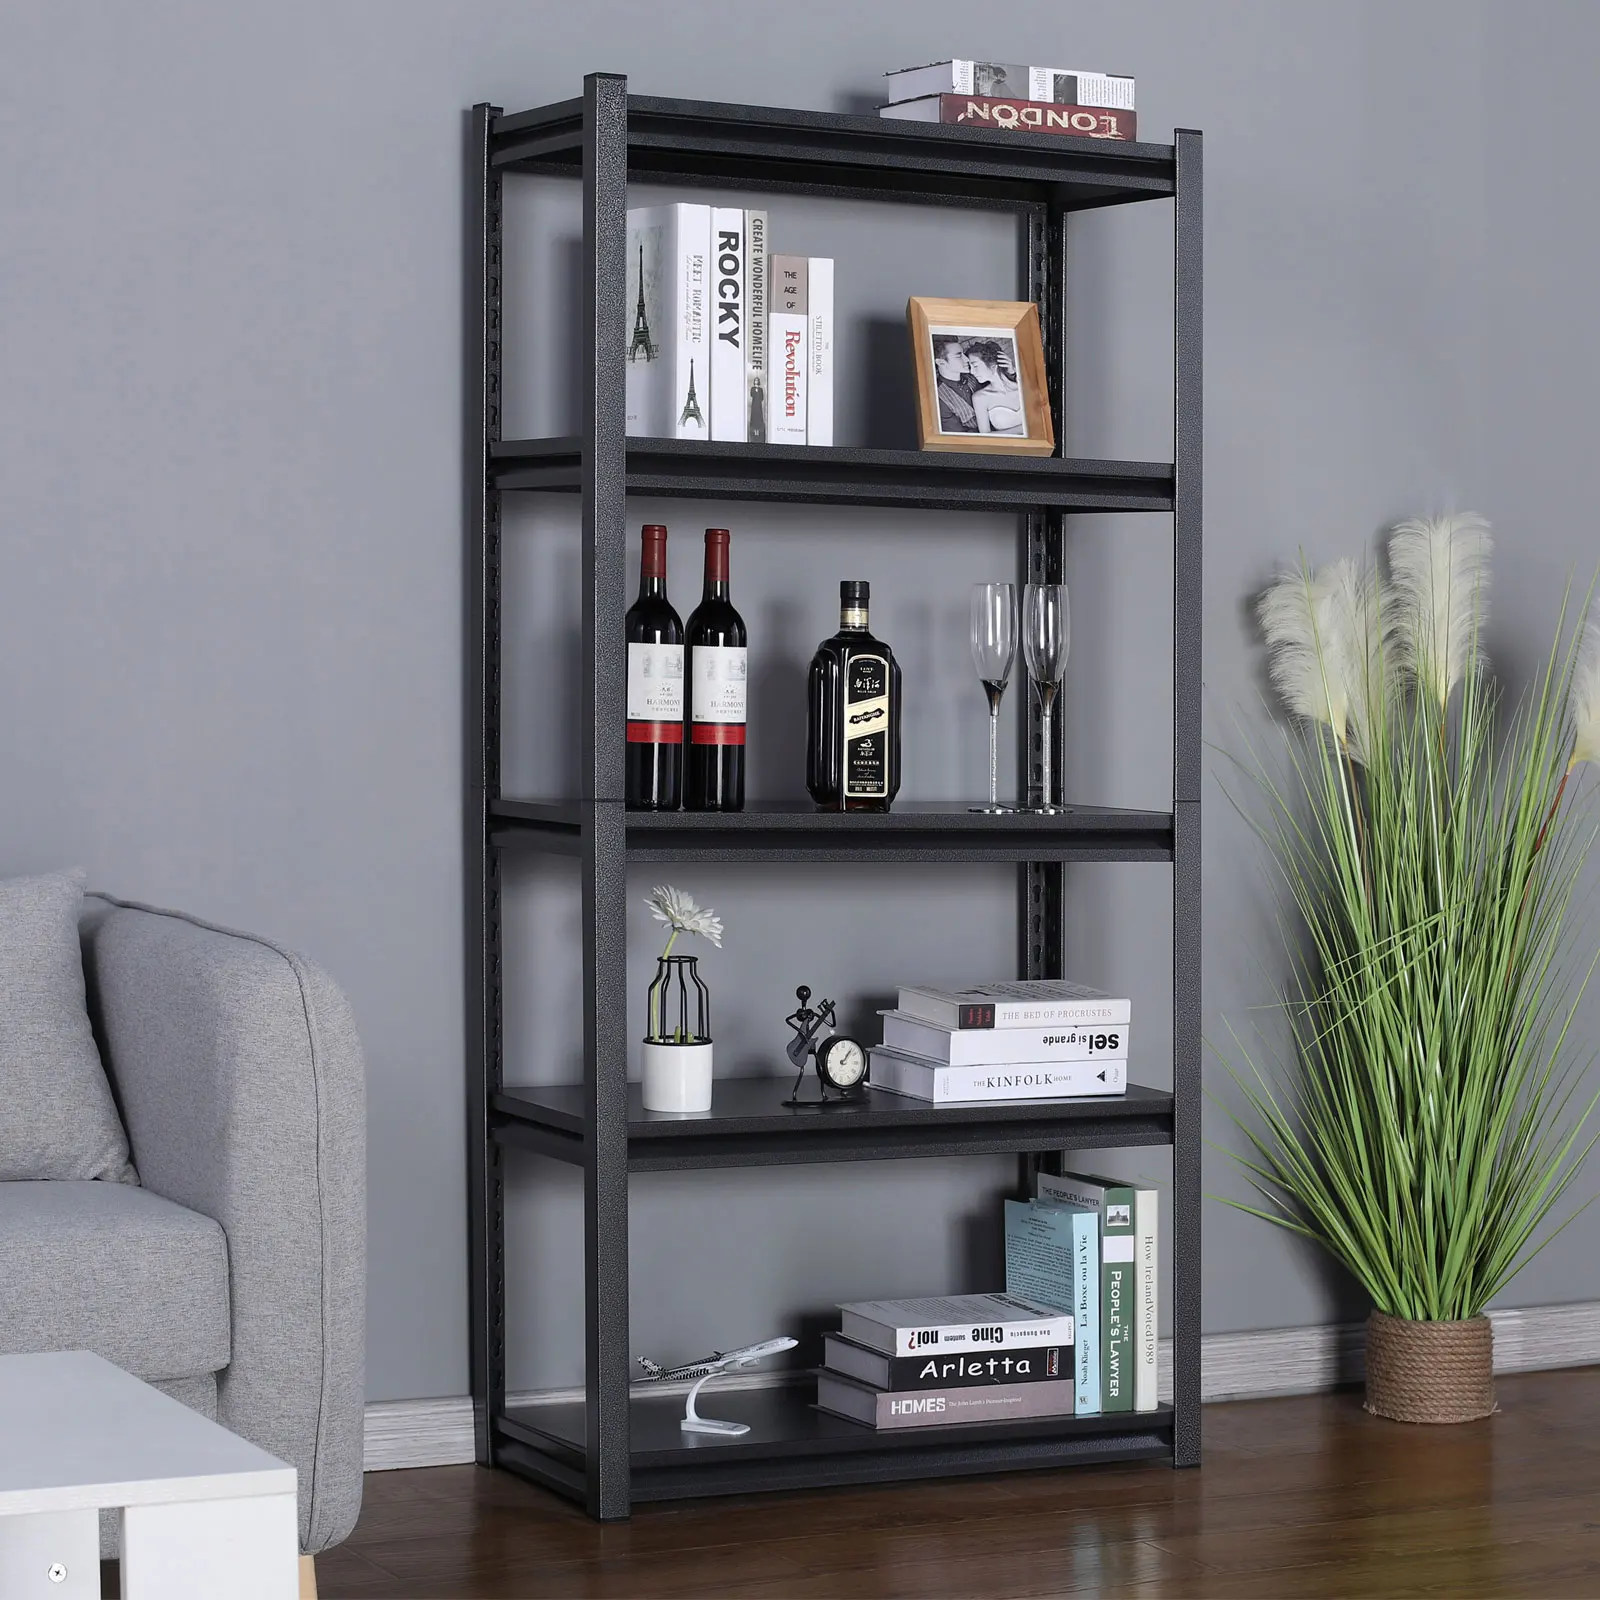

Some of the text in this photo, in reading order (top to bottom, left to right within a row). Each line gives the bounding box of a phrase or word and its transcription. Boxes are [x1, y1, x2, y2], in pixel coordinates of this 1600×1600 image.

[958, 101, 1126, 140] LONDON
[784, 270, 798, 280] THE
[692, 255, 703, 343] MEET ROMANTIC
[718, 230, 740, 349] ROCKY
[752, 218, 763, 370] CREATE WONDERFUL HOMELIFE
[784, 286, 798, 295] AGE
[786, 301, 796, 309] OF
[815, 315, 823, 375] STILETTO BOOK
[785, 329, 801, 417] Revolution
[646, 698, 681, 706] HARMONY
[710, 700, 745, 708] HARMONY
[1002, 1008, 1112, 1020] THE BED OF PROCRUSTES
[1042, 1033, 1120, 1054] sei si grande
[986, 1073, 1053, 1088] KINFOLK
[1042, 1186, 1053, 1196] THE
[1144, 1235, 1154, 1261] How
[1080, 1234, 1088, 1327] La Boxe ou la Vie
[908, 1330, 939, 1350] noi?
[971, 1326, 1004, 1343] Cine
[1110, 1270, 1122, 1397] PEOPLE'S LAWYER
[1081, 1340, 1090, 1363] Klieger
[919, 1357, 1031, 1379] Arletta
[890, 1397, 946, 1415] HOMES
